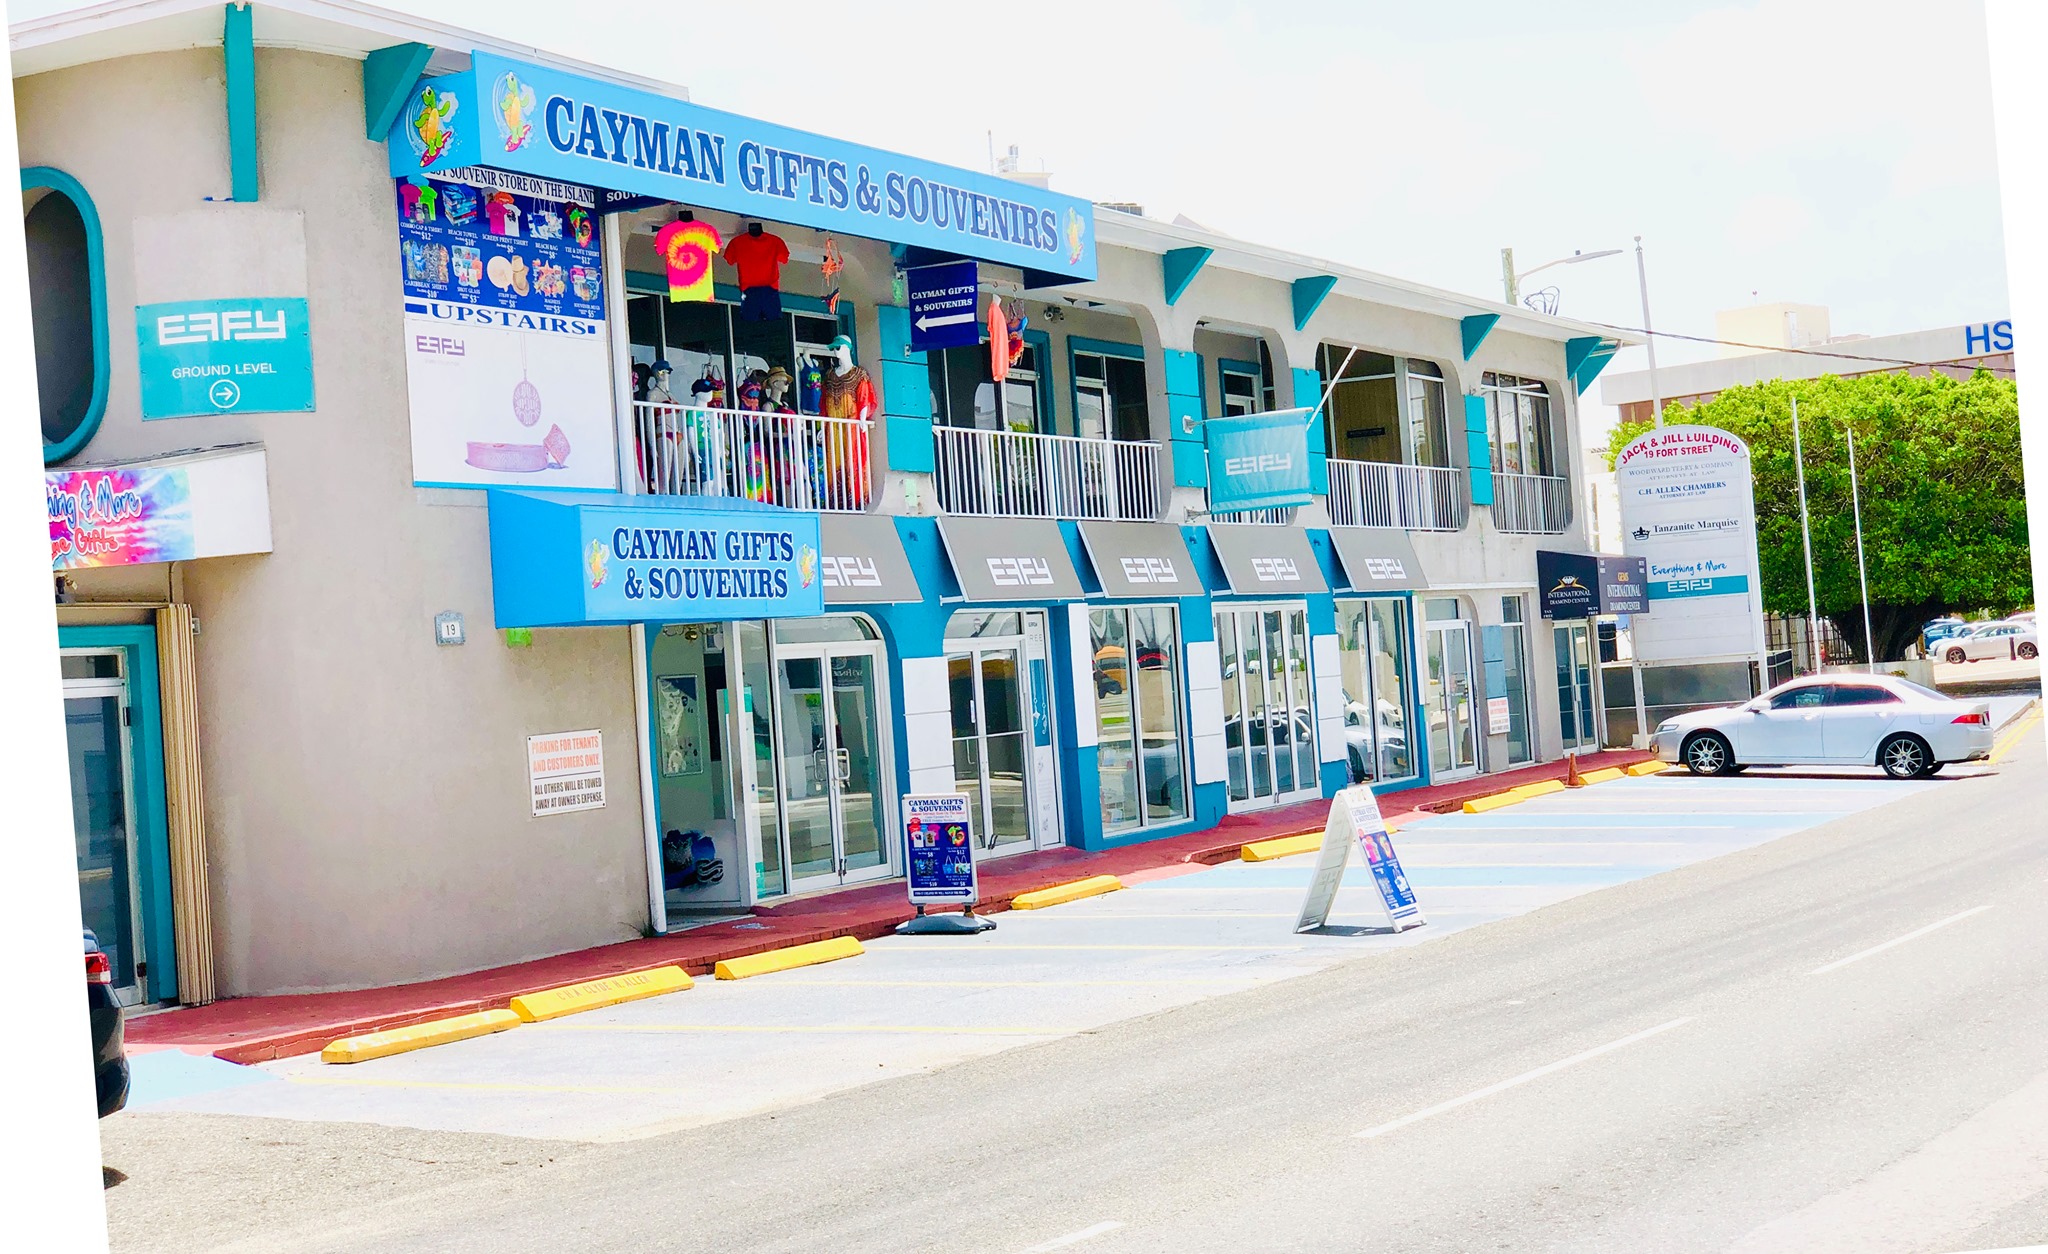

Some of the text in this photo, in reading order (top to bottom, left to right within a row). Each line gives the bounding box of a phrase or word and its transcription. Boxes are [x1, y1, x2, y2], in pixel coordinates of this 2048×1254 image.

[546, 95, 1058, 252] CAYMAN GIFTS & SOUVENIRS
[451, 167, 497, 186] SOUVENIR
[498, 173, 528, 191] STORE
[530, 179, 542, 193] ON
[545, 182, 564, 197] THE
[565, 185, 594, 203] ISLAND
[911, 285, 975, 300] CAYMAN GIFTS
[923, 299, 973, 311] SOUVENIRS
[157, 310, 287, 345] EFFY
[429, 303, 587, 335] UPSTAIRS
[416, 335, 465, 356] EFFY
[1966, 321, 2013, 354] HS
[172, 363, 277, 379] GROUND LEVEL
[1621, 441, 1648, 464] JACK
[1650, 438, 1658, 447] &
[1661, 434, 1683, 446] JILL
[1644, 445, 1713, 458] 19 FORT STREET
[1225, 452, 1291, 476] EFFY
[1629, 467, 1670, 476] WOODWARD
[1700, 461, 1734, 469] COMPANY
[97, 478, 140, 517] More
[1655, 486, 1681, 494] ALLEN
[1683, 481, 1726, 491] CHAMBERS
[1652, 518, 1739, 533] Tanzanite Marquise
[75, 528, 118, 553] Gifts
[613, 527, 794, 563] CAYMAN GIFTS
[986, 558, 1054, 586] EFFY
[1119, 557, 1178, 583] EFFY
[1250, 558, 1300, 581] EFFY
[1364, 558, 1407, 580] EFFY
[1651, 563, 1695, 578] Everything
[1705, 560, 1727, 572] More
[625, 567, 788, 599] & SOUVENIRS
[1667, 578, 1713, 593] EFFY
[1548, 590, 1591, 598] INTERNATIONAL
[446, 623, 456, 636] 19
[532, 735, 599, 754] PARKING FOR TENANTS
[533, 759, 546, 773] AND
[547, 755, 584, 771] CUSTOMERS
[535, 777, 602, 795] ALL OTHERS WILL BE TOWED
[535, 799, 550, 810] AWAY
[551, 797, 557, 808] AT
[558, 795, 581, 807] OWNER'S
[583, 982, 612, 994] CLYDE
[625, 975, 651, 987] ALLEN
